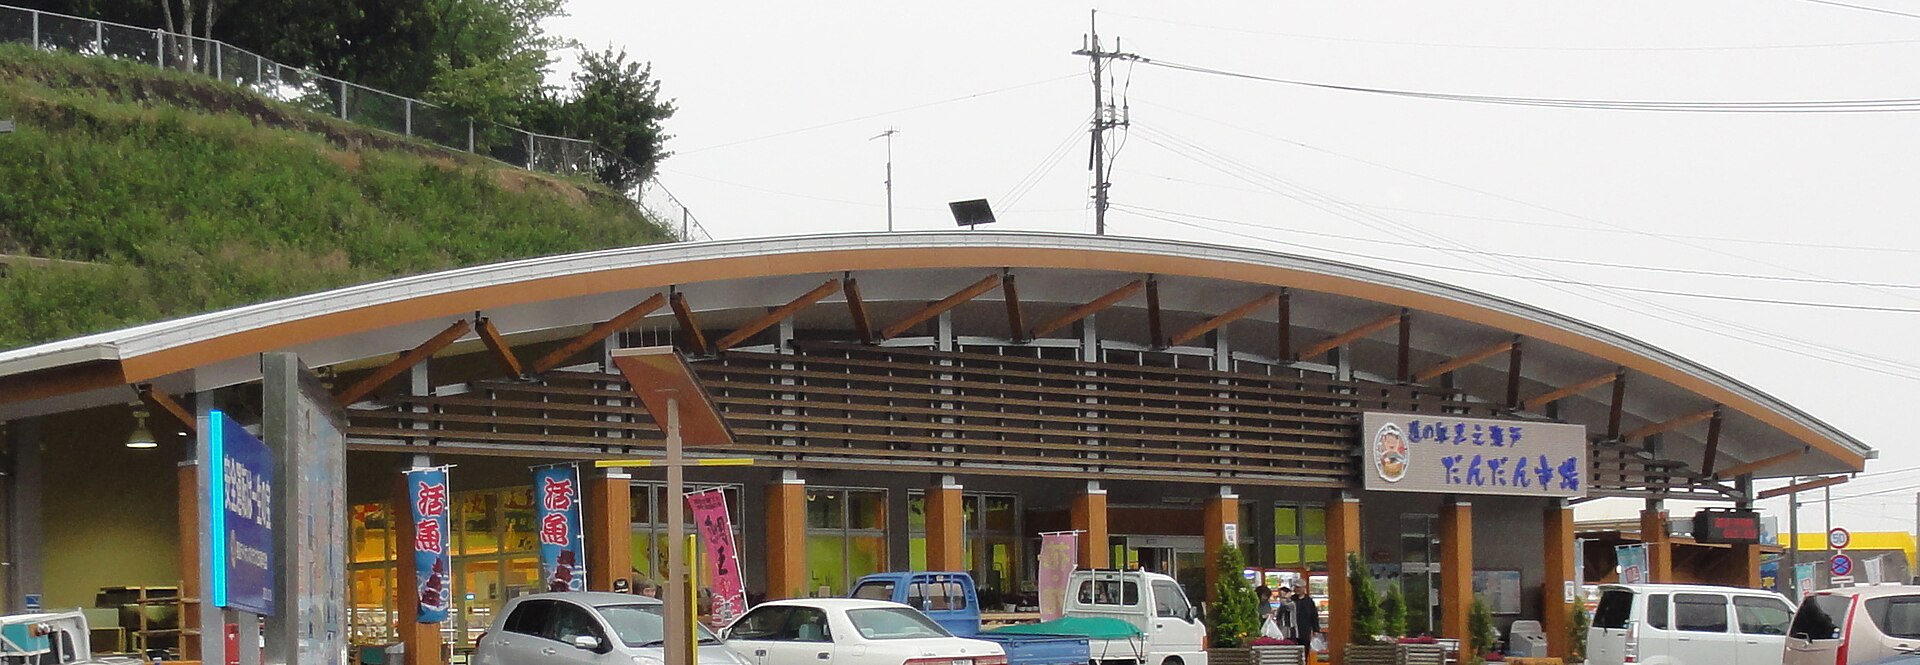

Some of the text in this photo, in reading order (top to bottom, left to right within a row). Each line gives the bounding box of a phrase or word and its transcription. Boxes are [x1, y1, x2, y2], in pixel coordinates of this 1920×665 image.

[1441, 454, 1580, 491] だんだん市場
[415, 481, 446, 554] 活魚
[540, 477, 574, 547] 活魚
[1832, 532, 1845, 545] 50
